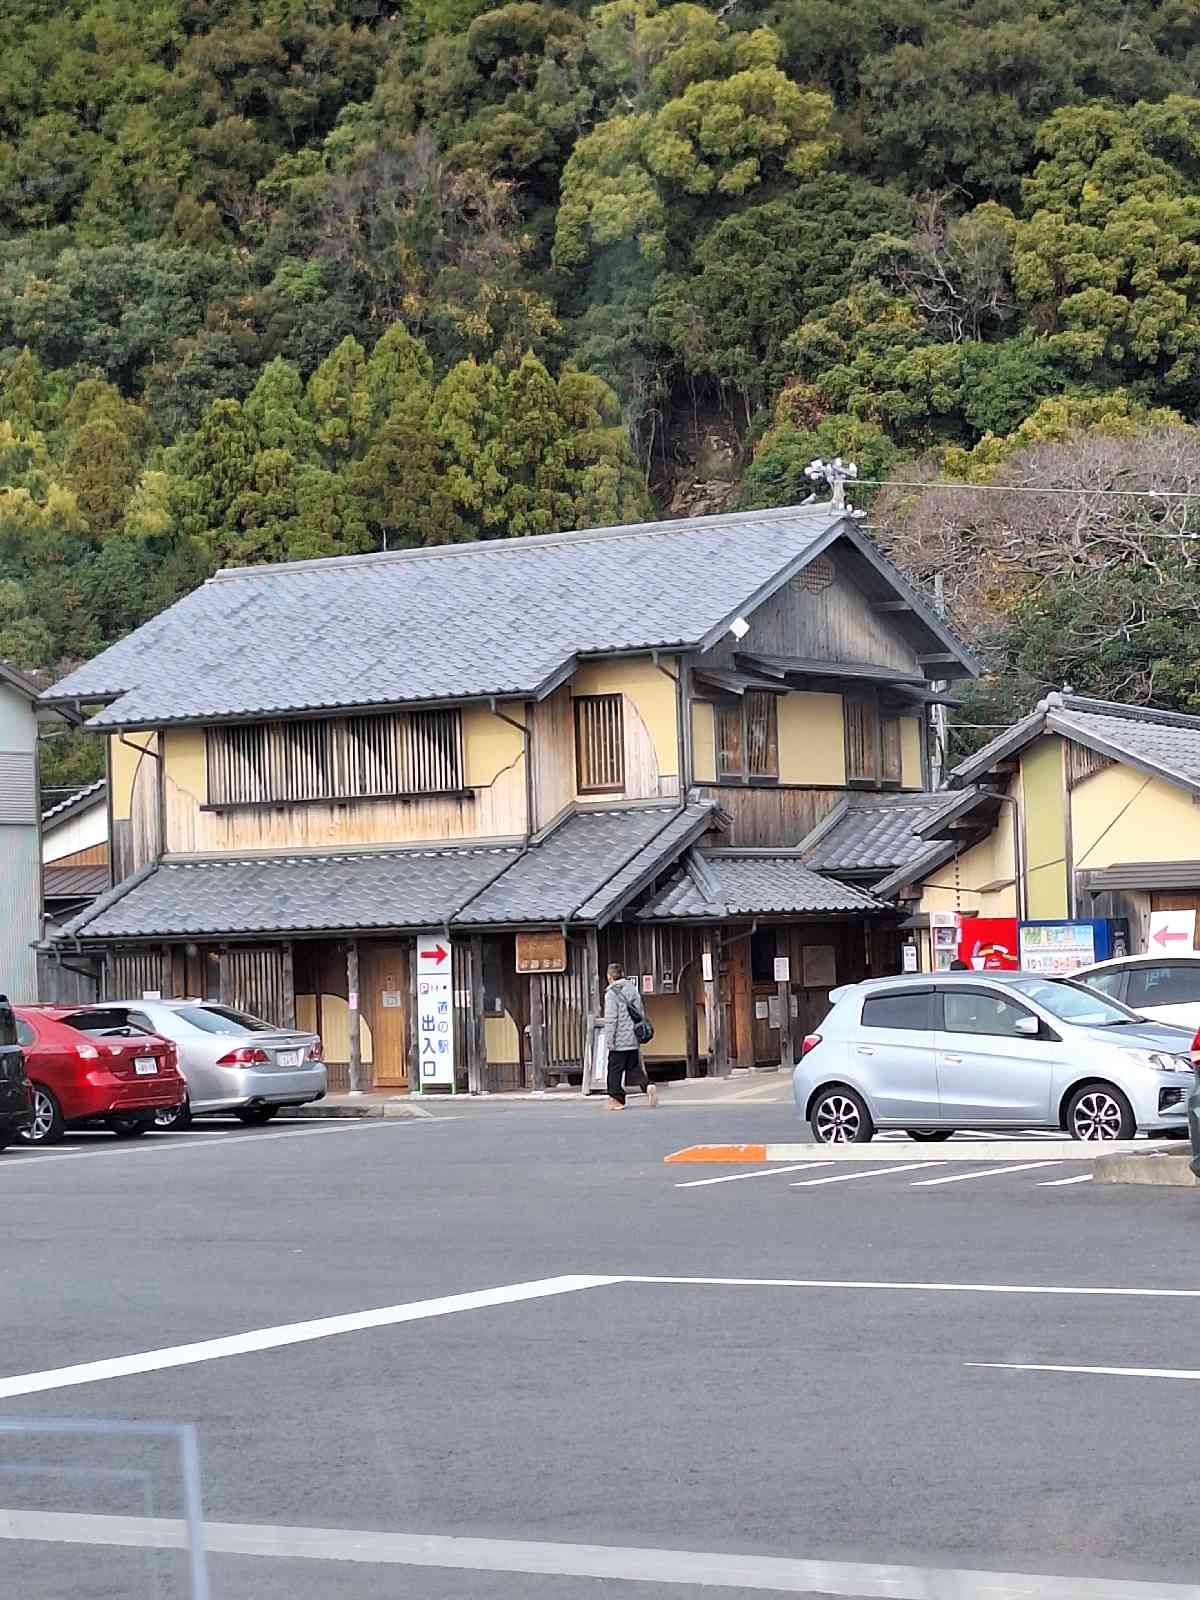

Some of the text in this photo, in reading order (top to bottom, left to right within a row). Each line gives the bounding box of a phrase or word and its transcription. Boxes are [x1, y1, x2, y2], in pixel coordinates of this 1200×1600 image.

[422, 1014, 436, 1077] 出入口
[437, 1001, 449, 1054] 道の駅
